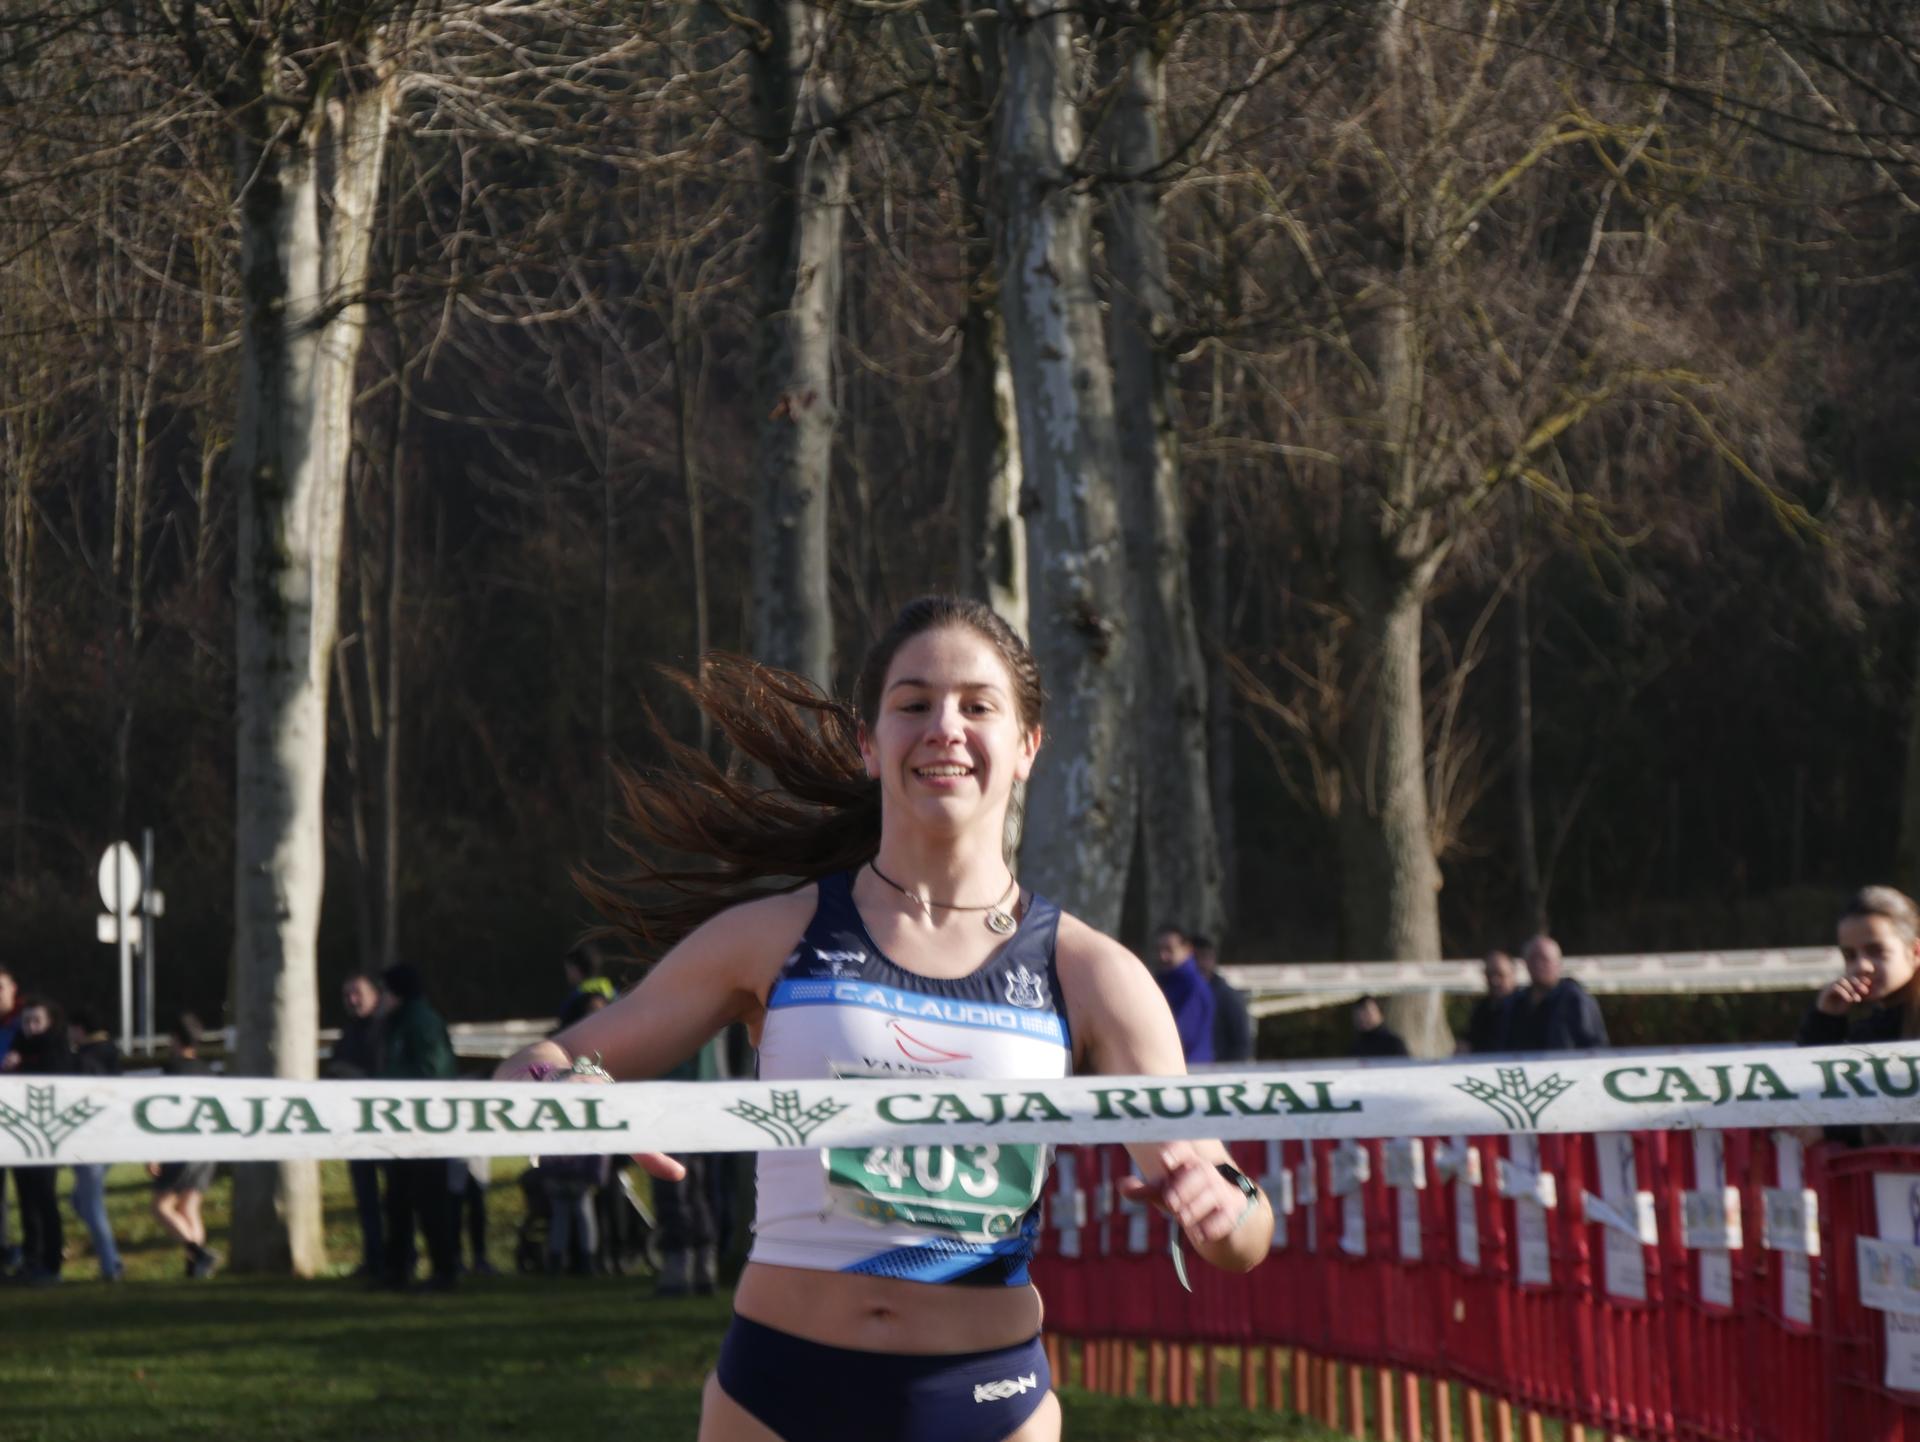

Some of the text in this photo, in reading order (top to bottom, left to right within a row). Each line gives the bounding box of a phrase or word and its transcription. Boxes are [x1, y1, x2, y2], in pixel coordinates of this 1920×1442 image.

[877, 1083, 1364, 1127] CAJA RURAL
[1603, 1063, 1801, 1107] CAJA
[133, 1095, 629, 1134] CAJA RURAL
[863, 1143, 1000, 1198] 403
